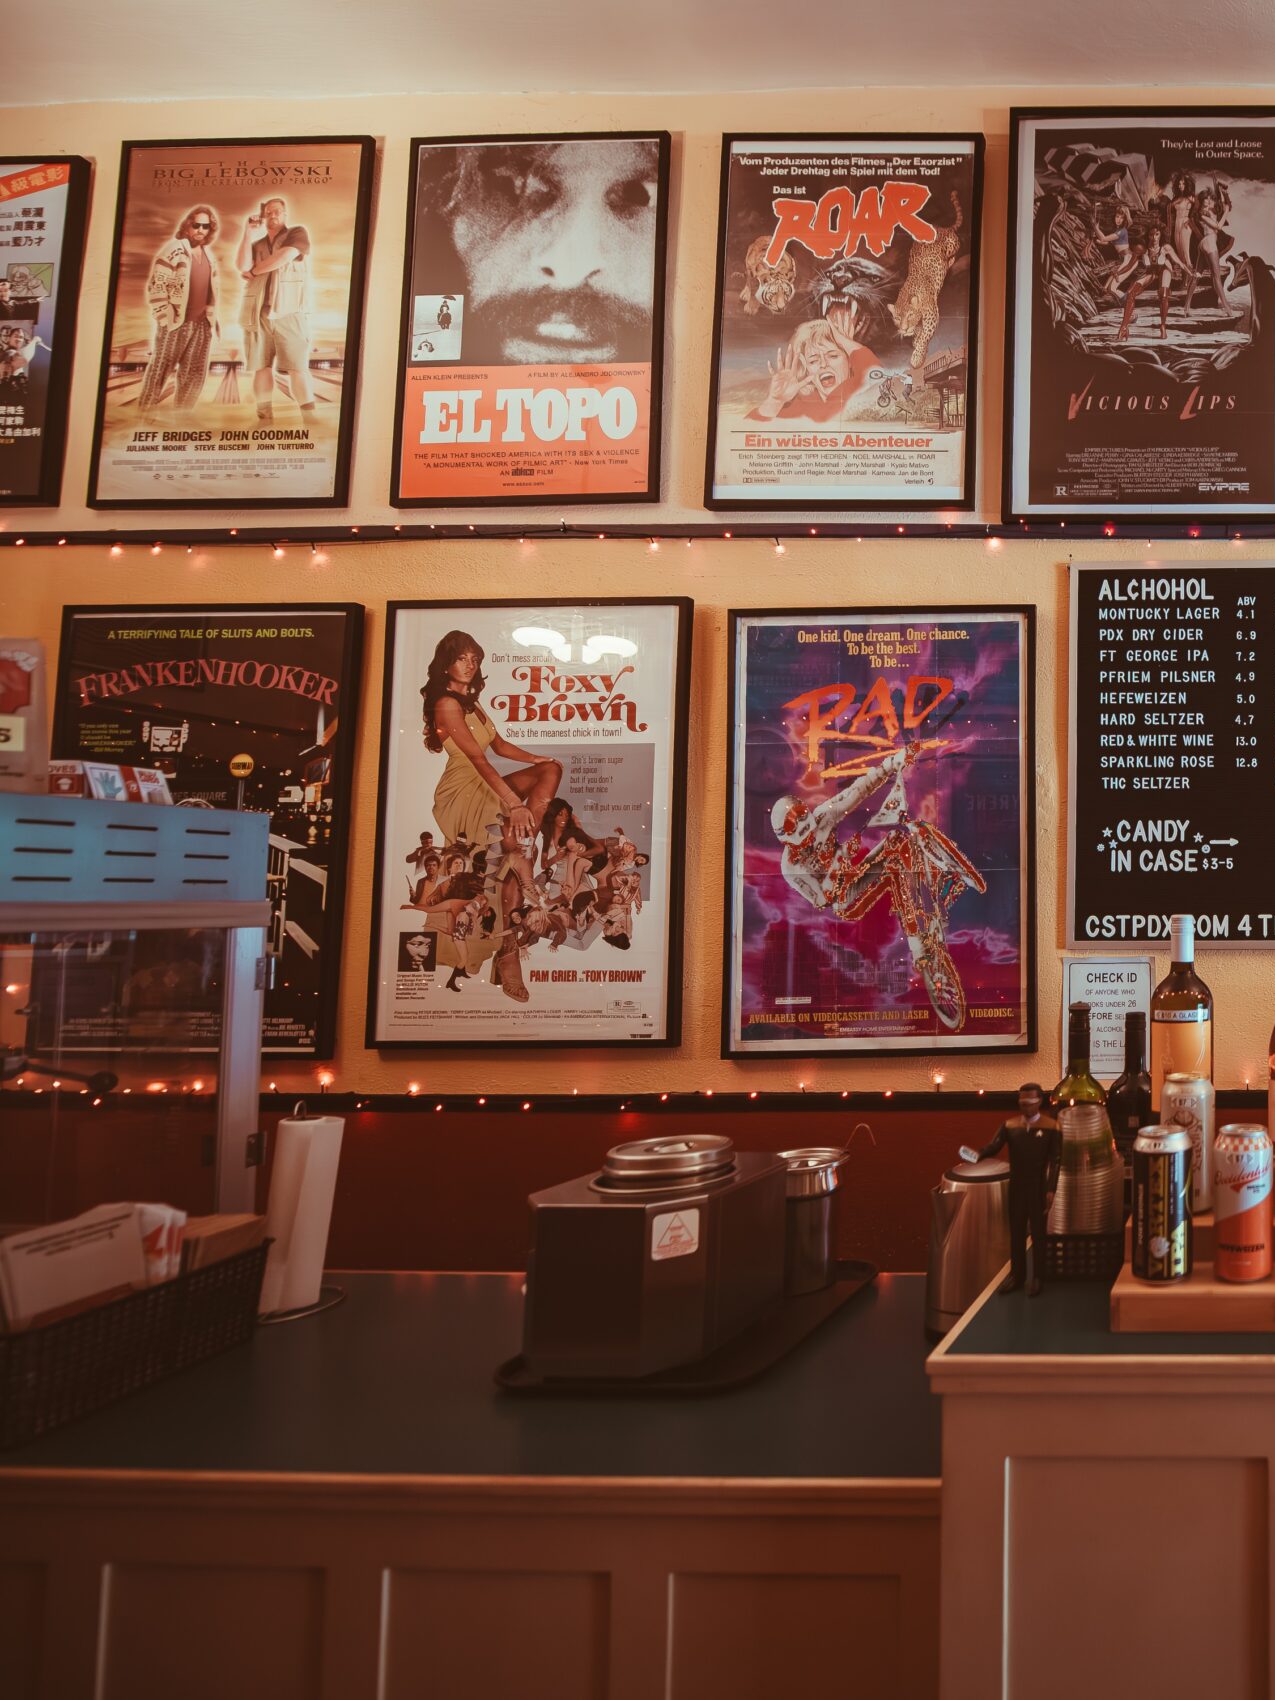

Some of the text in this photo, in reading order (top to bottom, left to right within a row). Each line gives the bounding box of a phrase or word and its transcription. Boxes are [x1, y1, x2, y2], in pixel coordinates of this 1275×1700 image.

[1161, 140, 1193, 149] They're
[1196, 140, 1213, 148] Lost
[1235, 139, 1261, 147] Loose
[738, 156, 885, 165] Vom Produzenten des Filmes
[154, 165, 331, 179] BIG LEBOWSKI
[762, 181, 938, 269] ROAR
[1068, 374, 1235, 420] VICIOUS LIPS
[420, 387, 637, 443] EL TOPO
[133, 430, 309, 441] JEFF BRIDGES JOHN GOODMAN
[745, 433, 934, 447] Ein wüstes Abenteuer
[1099, 608, 1219, 620] MONTUCKY LAGER
[108, 628, 314, 639] A TERRIFYING TALE OF SLUTS AND BOLTS.
[798, 627, 969, 643] One kid. One dream. One chance.
[1100, 629, 1203, 640] PDX DRY CIDER
[1100, 650, 1209, 662] FT GEORGE IPA
[78, 659, 338, 707] FRANKENHOOKER
[1100, 671, 1215, 683] PFRIEM PILSNER
[1100, 692, 1186, 704] HEFEWEIZEN
[782, 676, 953, 771] RAD
[1101, 713, 1204, 725] HARD SELTZER
[506, 727, 621, 737] She's the meanest chick town!
[1101, 756, 1214, 768] SPARKLING ROSE
[1102, 777, 1189, 789] THC SELTZER
[1115, 820, 1189, 844] CANDY
[1111, 850, 1131, 872] IN
[1140, 849, 1198, 872] CASE
[1238, 915, 1252, 936] 4
[530, 970, 577, 982] PAM GRIER
[1087, 973, 1137, 983] CHECK ID
